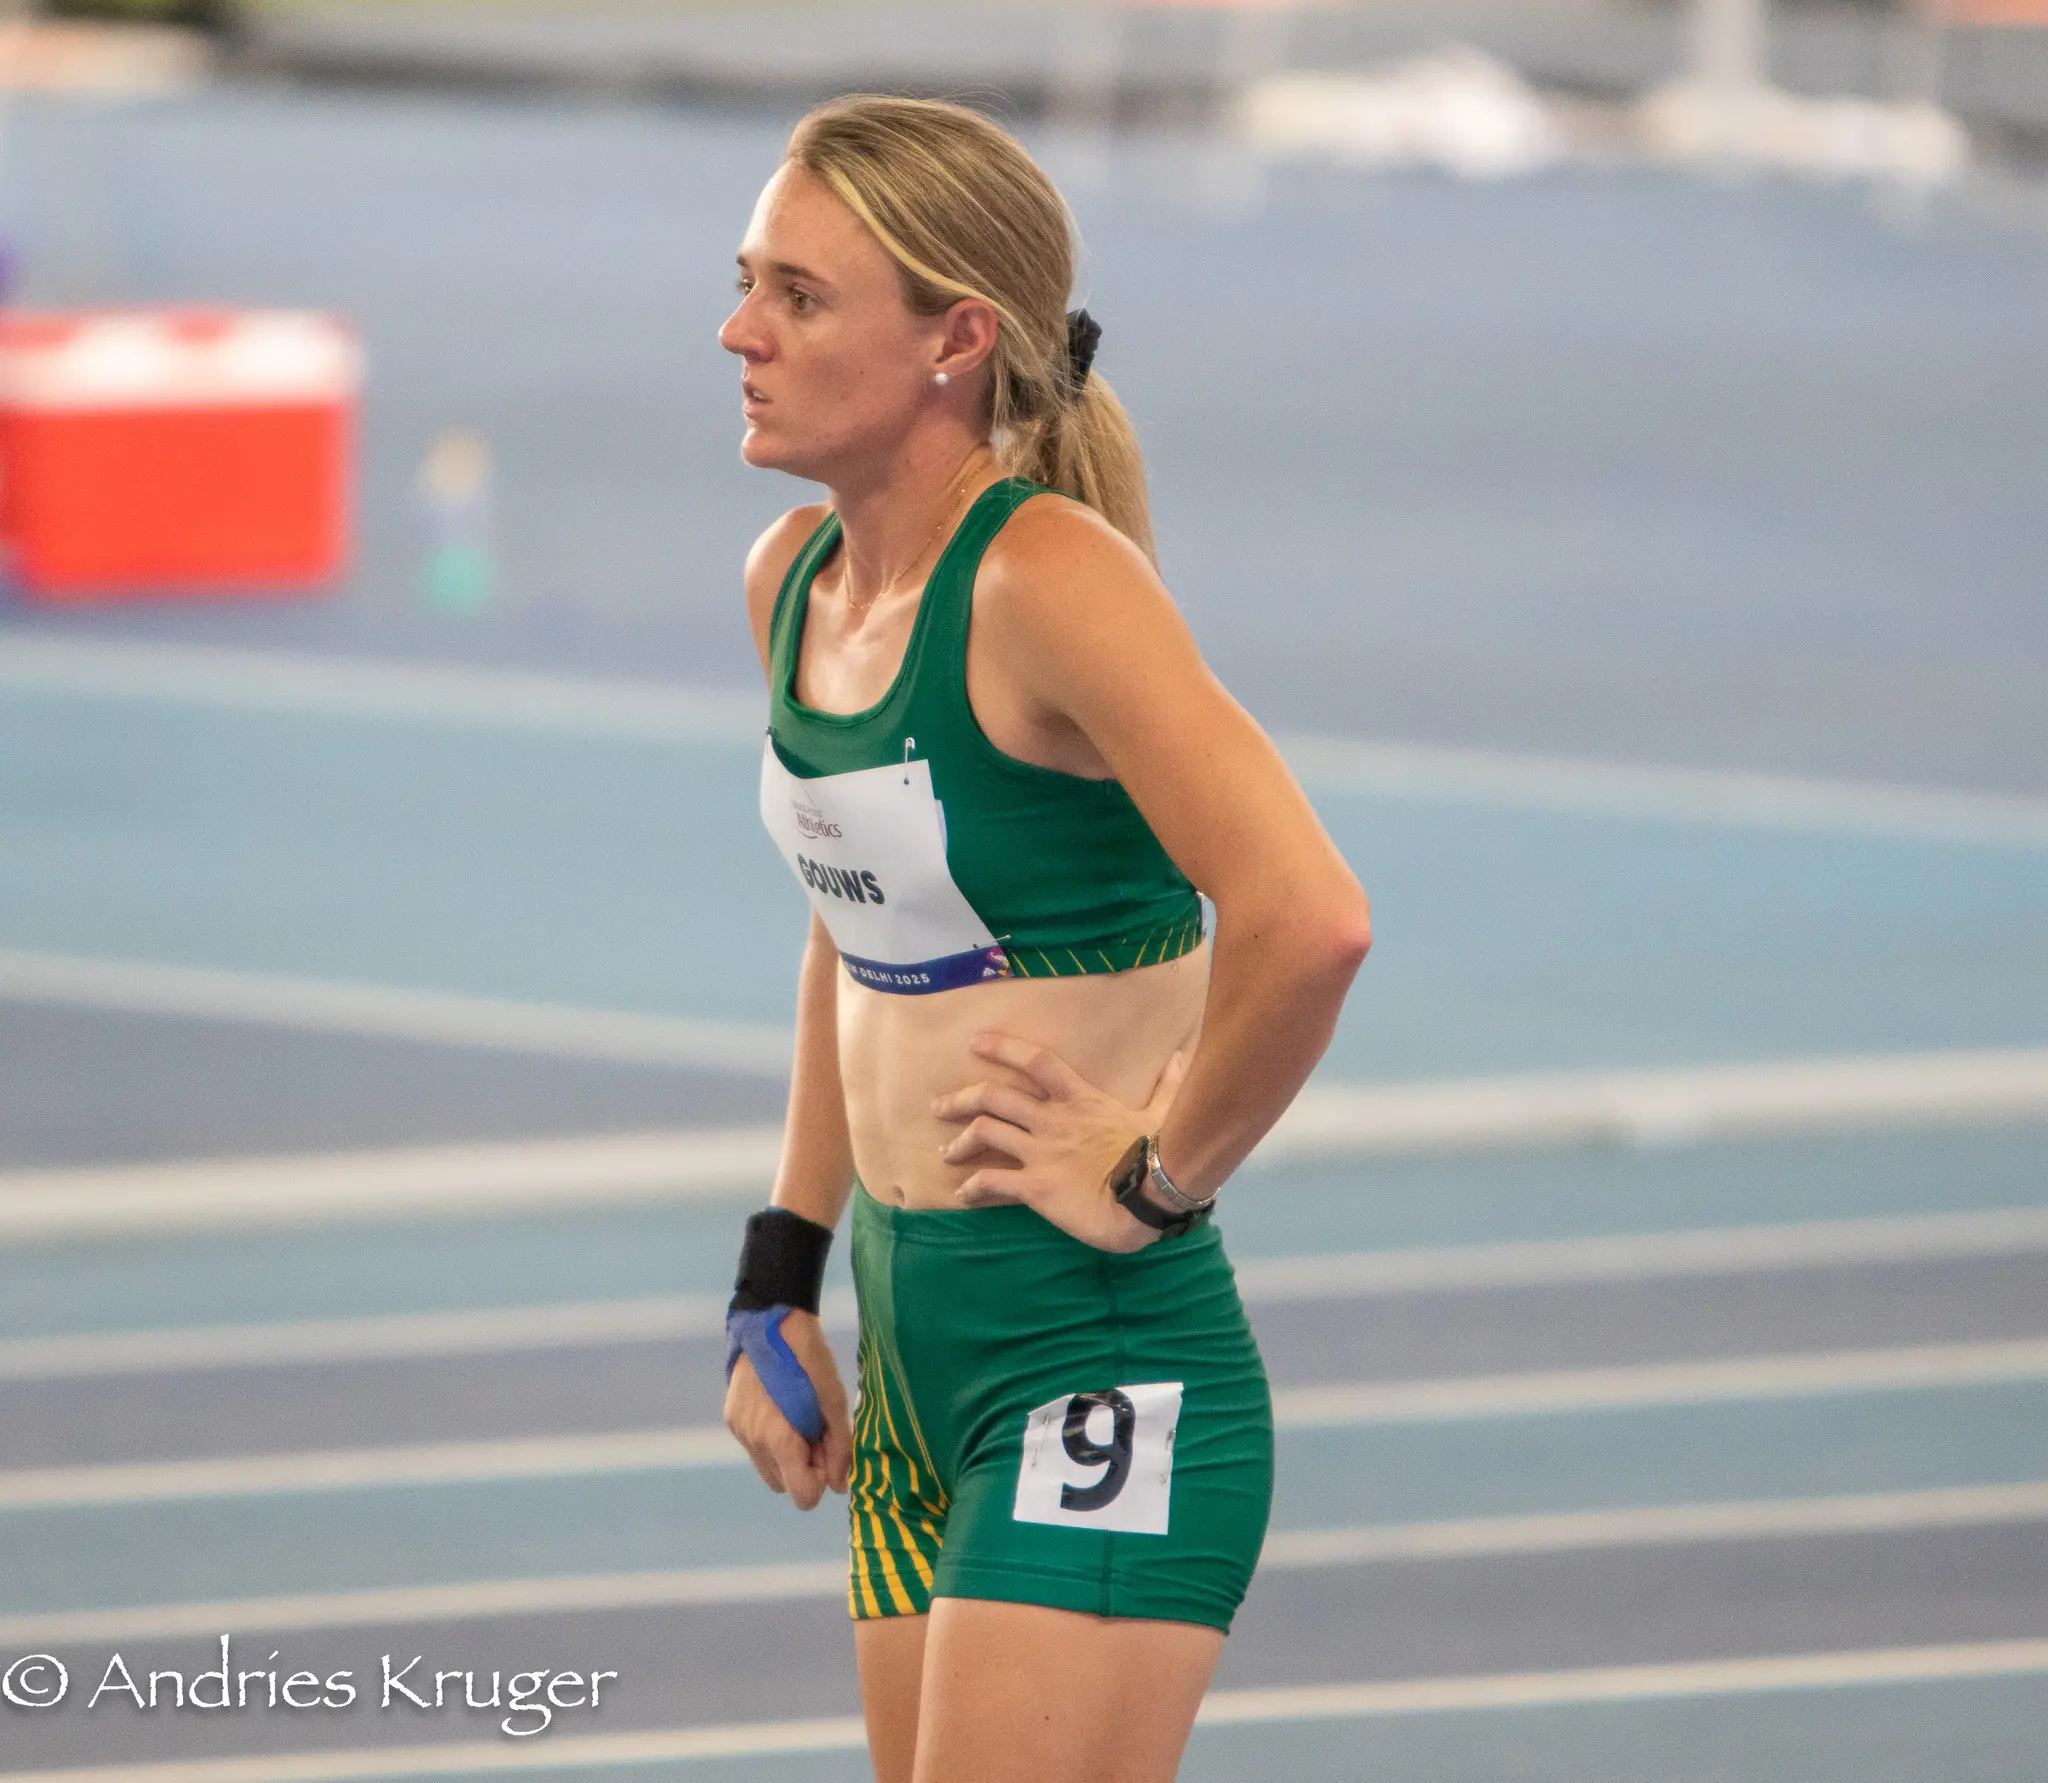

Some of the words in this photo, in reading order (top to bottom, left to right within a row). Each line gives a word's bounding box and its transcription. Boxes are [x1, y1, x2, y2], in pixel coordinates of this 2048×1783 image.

[796, 810, 842, 838] Athletics
[797, 853, 886, 905] GOUWS
[860, 967, 893, 983] DELHI
[894, 973, 930, 985] 2025
[1060, 1388, 1136, 1512] 9
